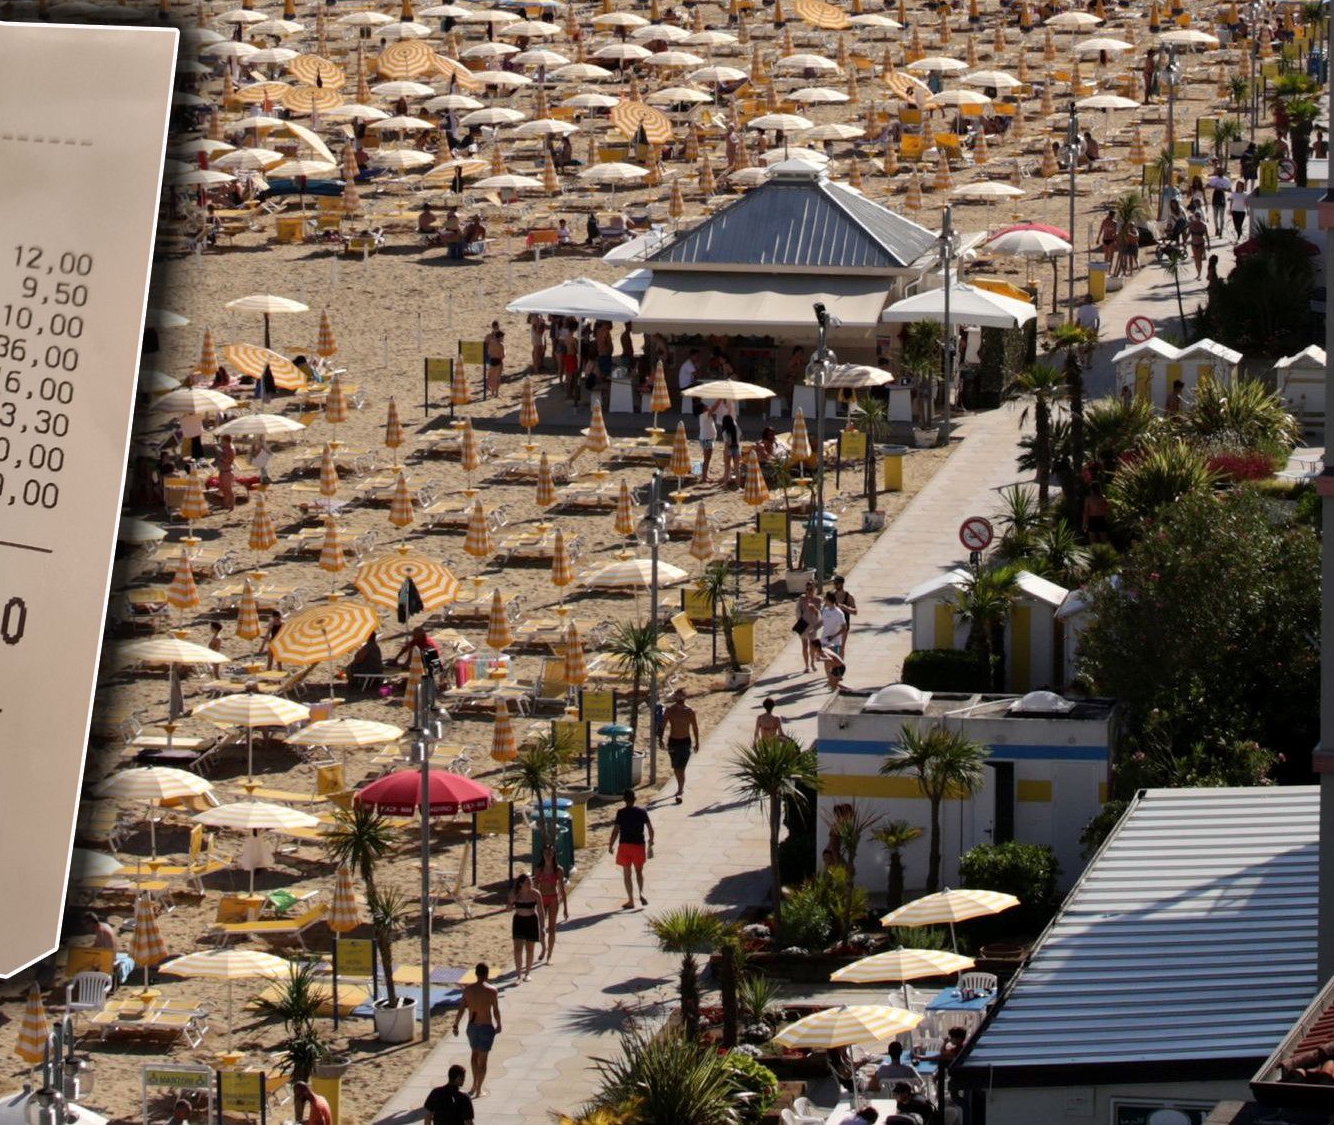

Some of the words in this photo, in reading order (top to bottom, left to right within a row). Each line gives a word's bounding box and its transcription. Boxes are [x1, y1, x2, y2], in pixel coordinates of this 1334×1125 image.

[14, 245, 93, 276] 12,00
[22, 276, 88, 308] 9,50
[3, 304, 84, 339] 10,00
[0, 402, 69, 437] 3,30
